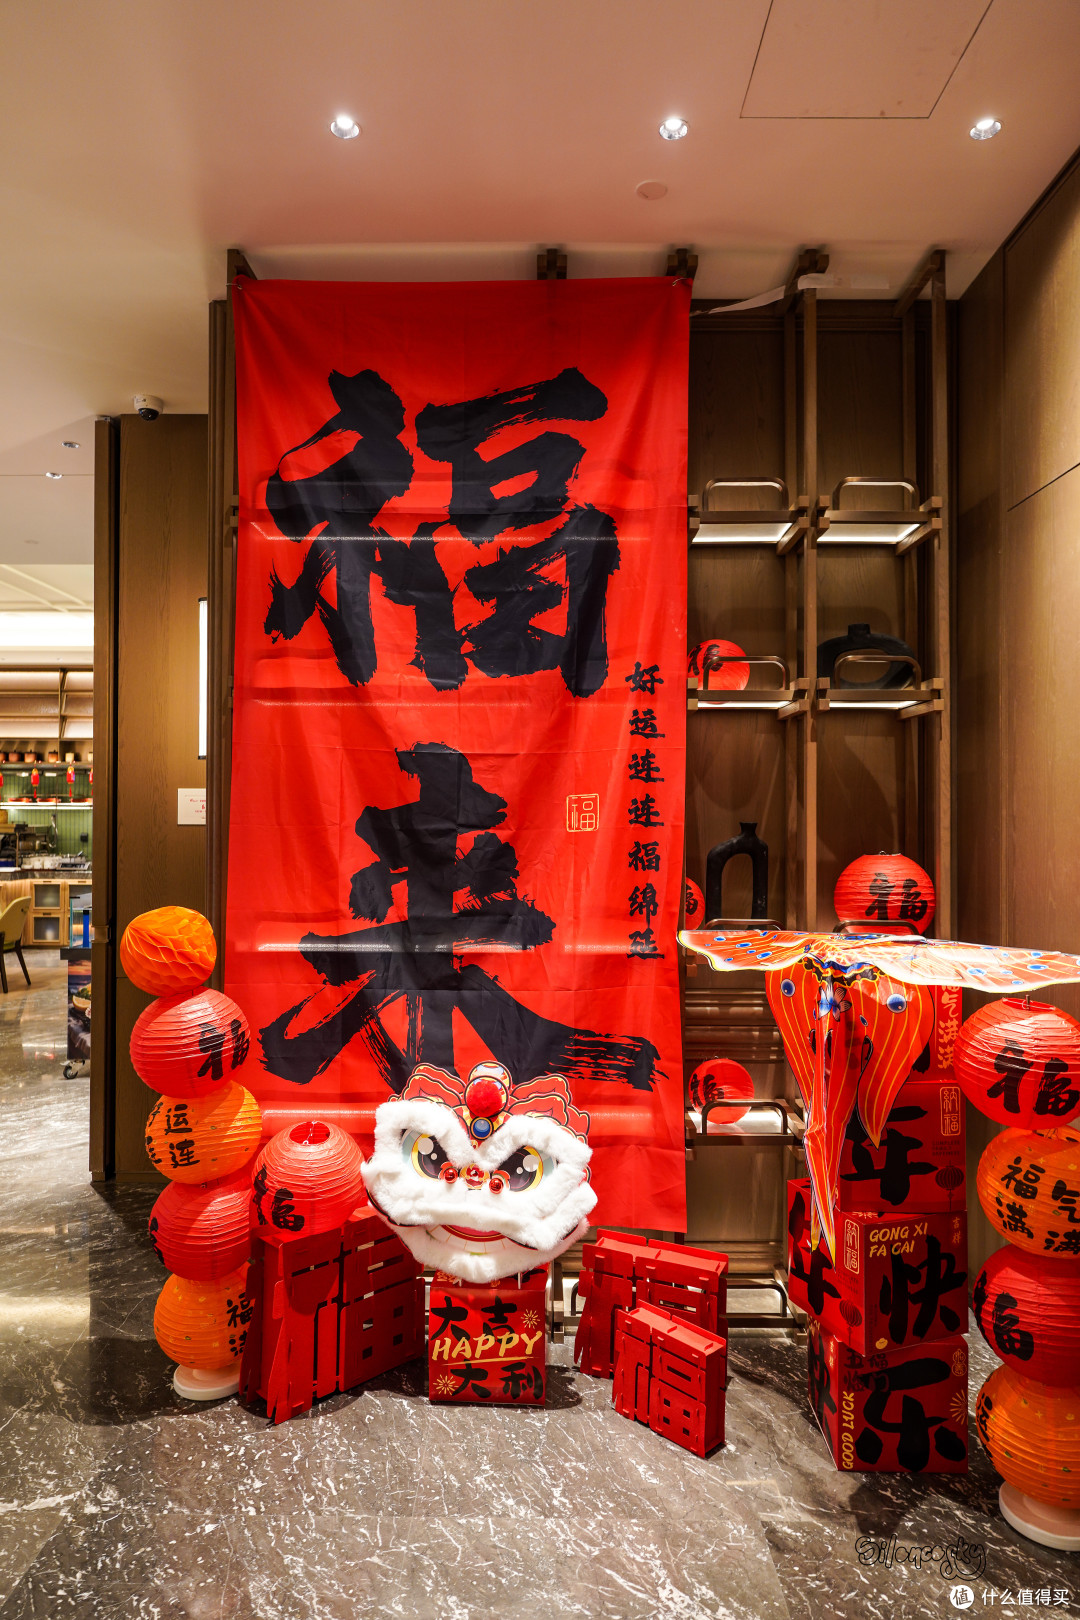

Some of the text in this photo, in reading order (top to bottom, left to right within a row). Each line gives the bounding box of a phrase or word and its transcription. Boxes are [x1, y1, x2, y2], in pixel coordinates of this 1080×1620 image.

[259, 366, 669, 1092] 福来
[570, 795, 597, 831] 福
[625, 661, 666, 961] 好运连连福绵延
[864, 872, 928, 921] 福
[197, 1019, 250, 1081] 福
[986, 1038, 1080, 1117] 福
[253, 1163, 305, 1232] 福
[869, 1222, 928, 1243] GONG XI
[869, 1240, 915, 1258] FA CAI
[430, 1296, 518, 1346] 大吉
[879, 1234, 968, 1345] 快
[973, 1270, 1035, 1362] 福
[431, 1330, 543, 1361] HAPPY
[451, 1358, 544, 1400] 大利
[842, 1391, 855, 1470] GOOD LUCK
[855, 1357, 967, 1472] 乐
